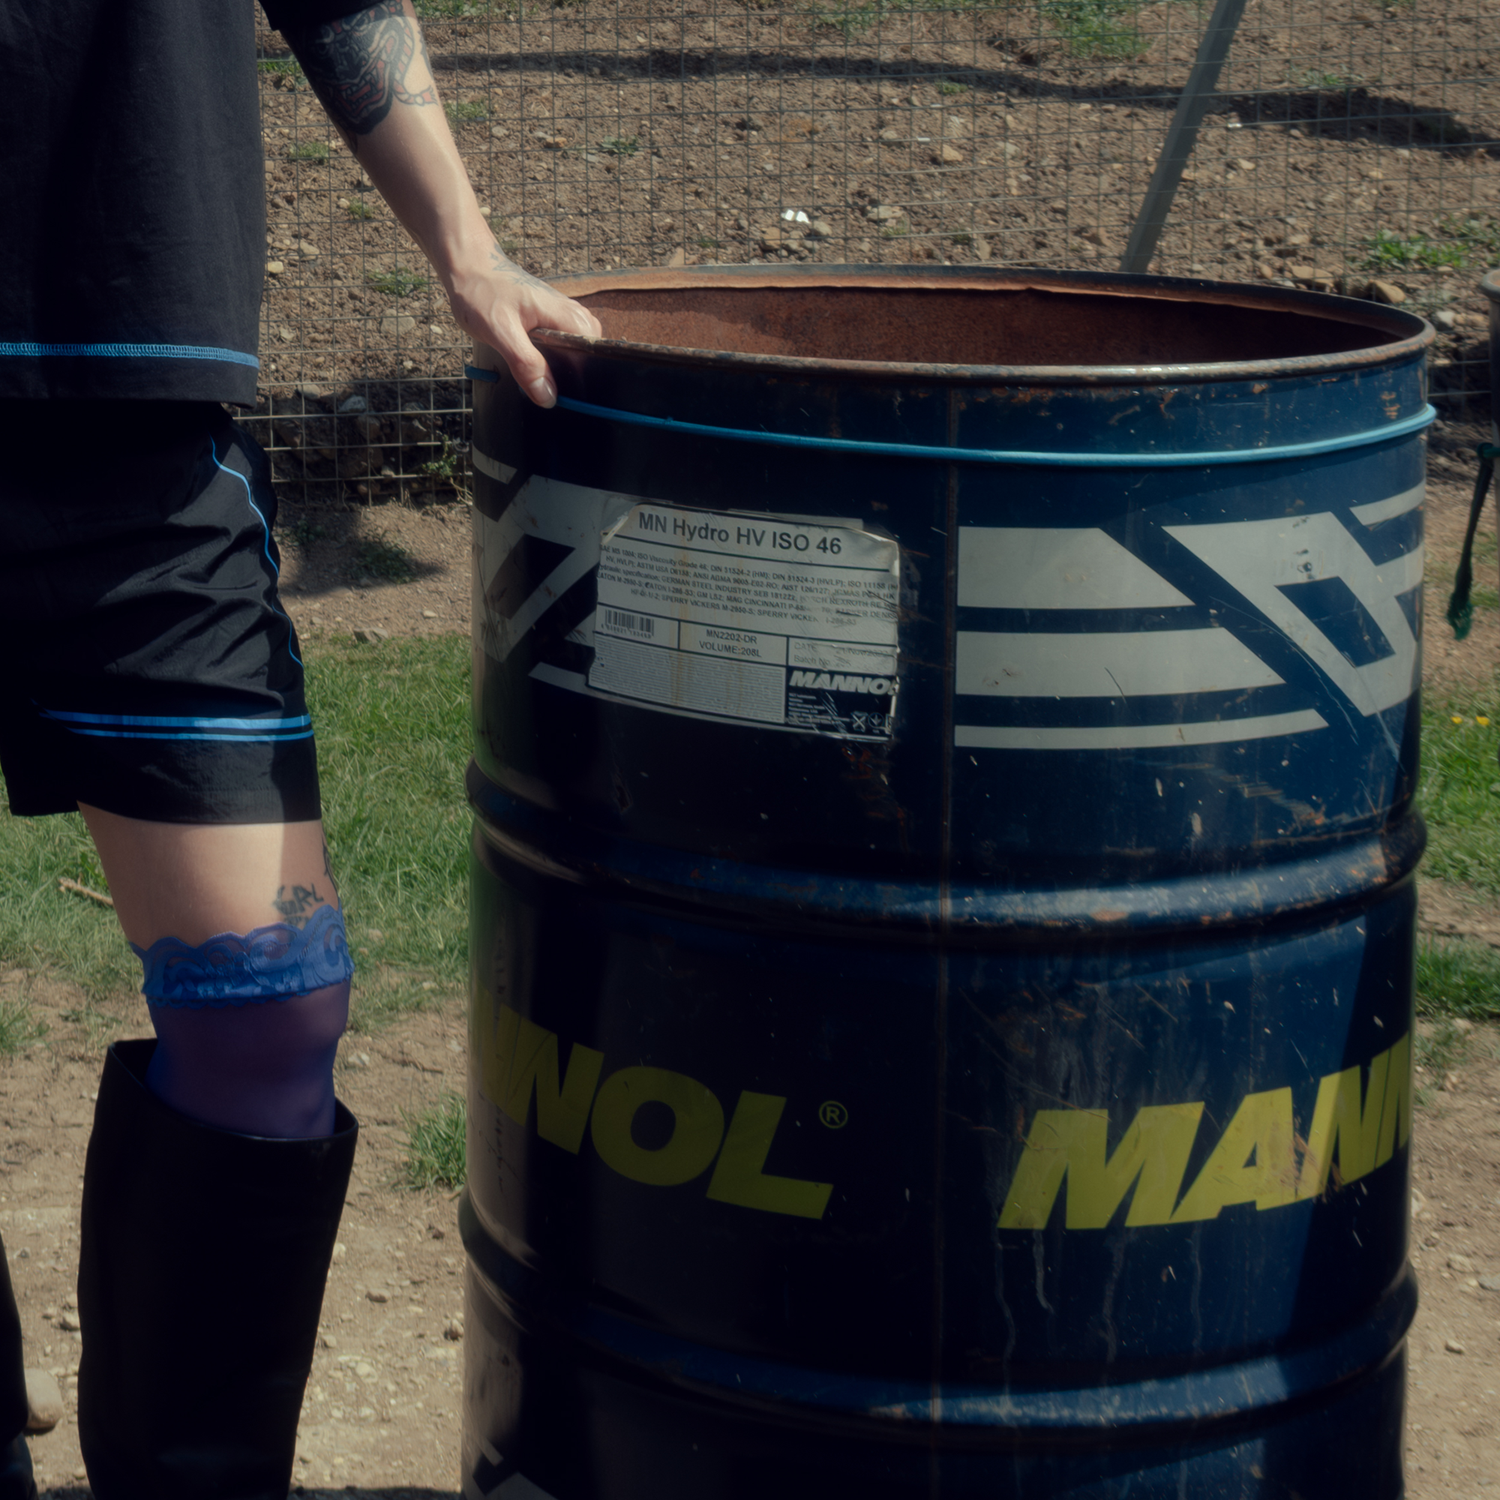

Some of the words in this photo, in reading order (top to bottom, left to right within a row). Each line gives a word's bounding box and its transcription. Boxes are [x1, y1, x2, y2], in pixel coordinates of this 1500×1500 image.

[639, 511, 667, 533] MN
[673, 517, 729, 542] Hydro
[736, 526, 766, 547] HV
[772, 530, 810, 552] ISO
[815, 536, 842, 555] 46
[706, 628, 758, 644] MN2202-DR
[699, 640, 762, 658] VOLUME:208L
